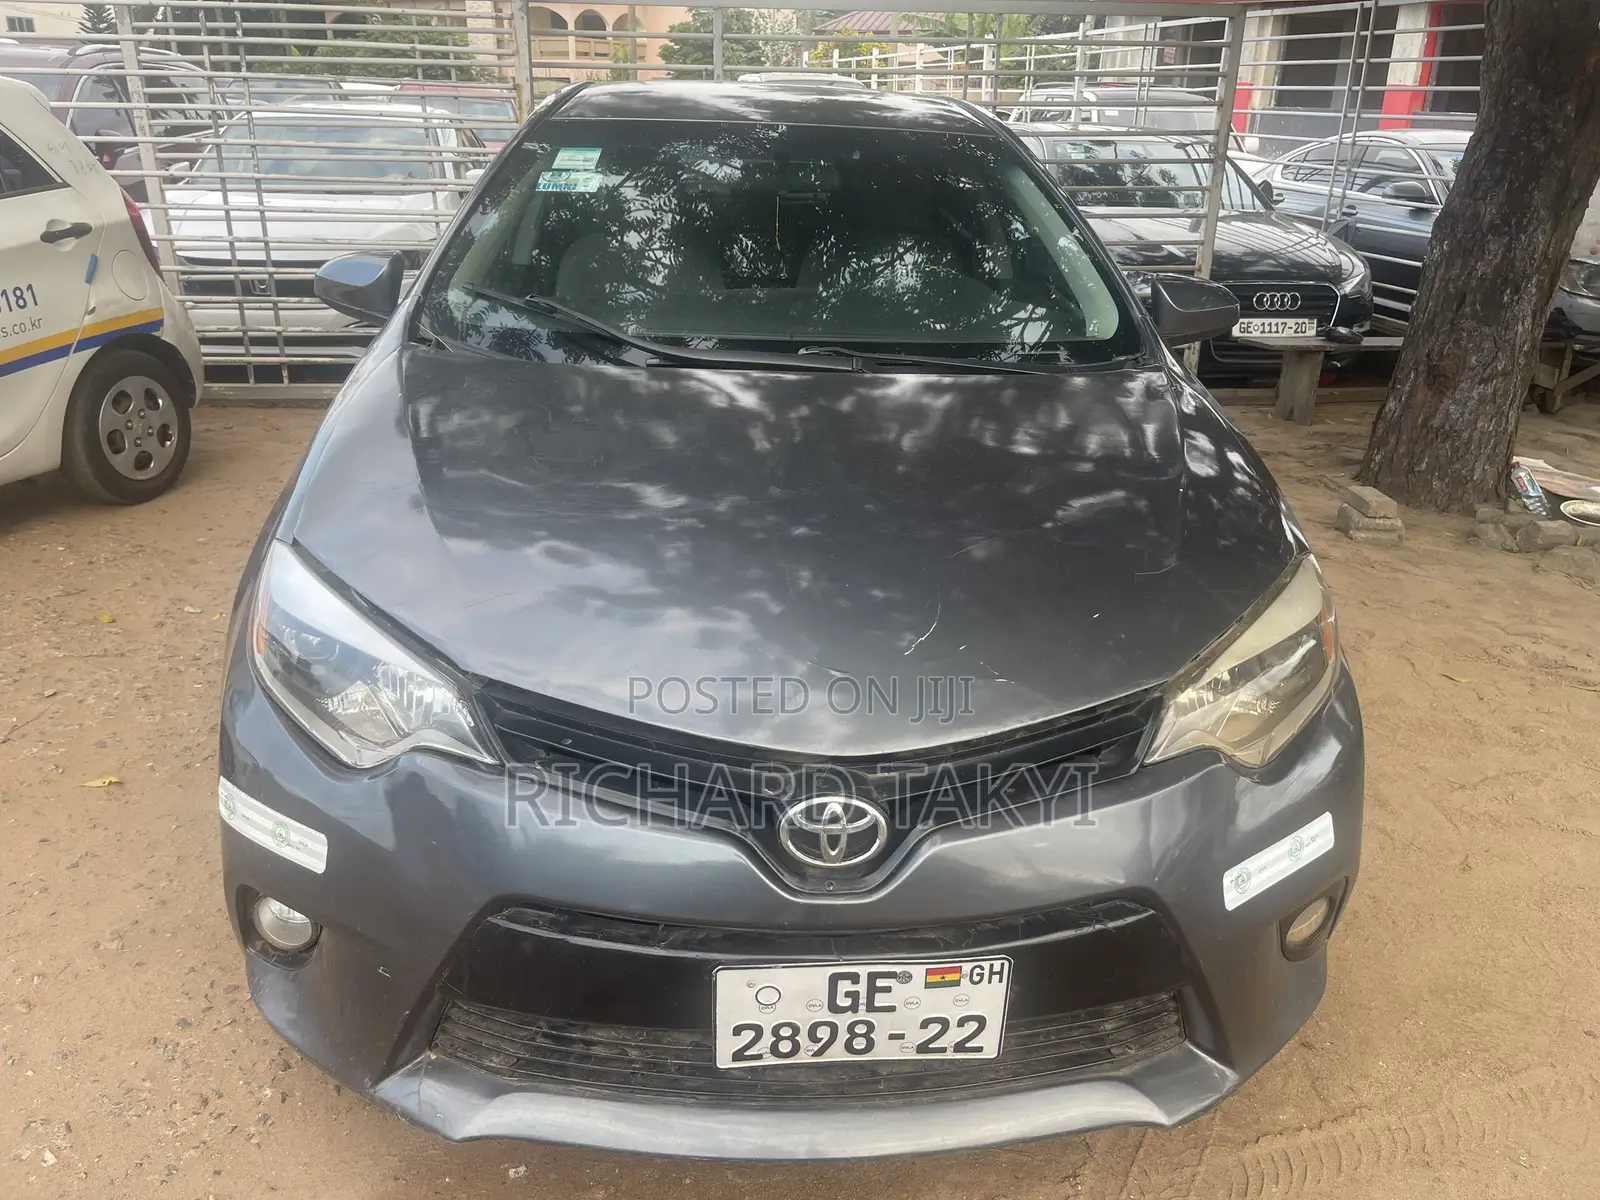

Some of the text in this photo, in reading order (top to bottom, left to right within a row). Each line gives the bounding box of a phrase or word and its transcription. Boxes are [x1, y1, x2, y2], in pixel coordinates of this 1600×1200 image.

[0, 284, 38, 313] 181
[0, 316, 42, 338] s.co.kr
[1239, 322, 1253, 334] GE
[1260, 321, 1307, 334] 1117-20
[828, 962, 1005, 1014] GE GH
[731, 1014, 987, 1062] 2898-22
